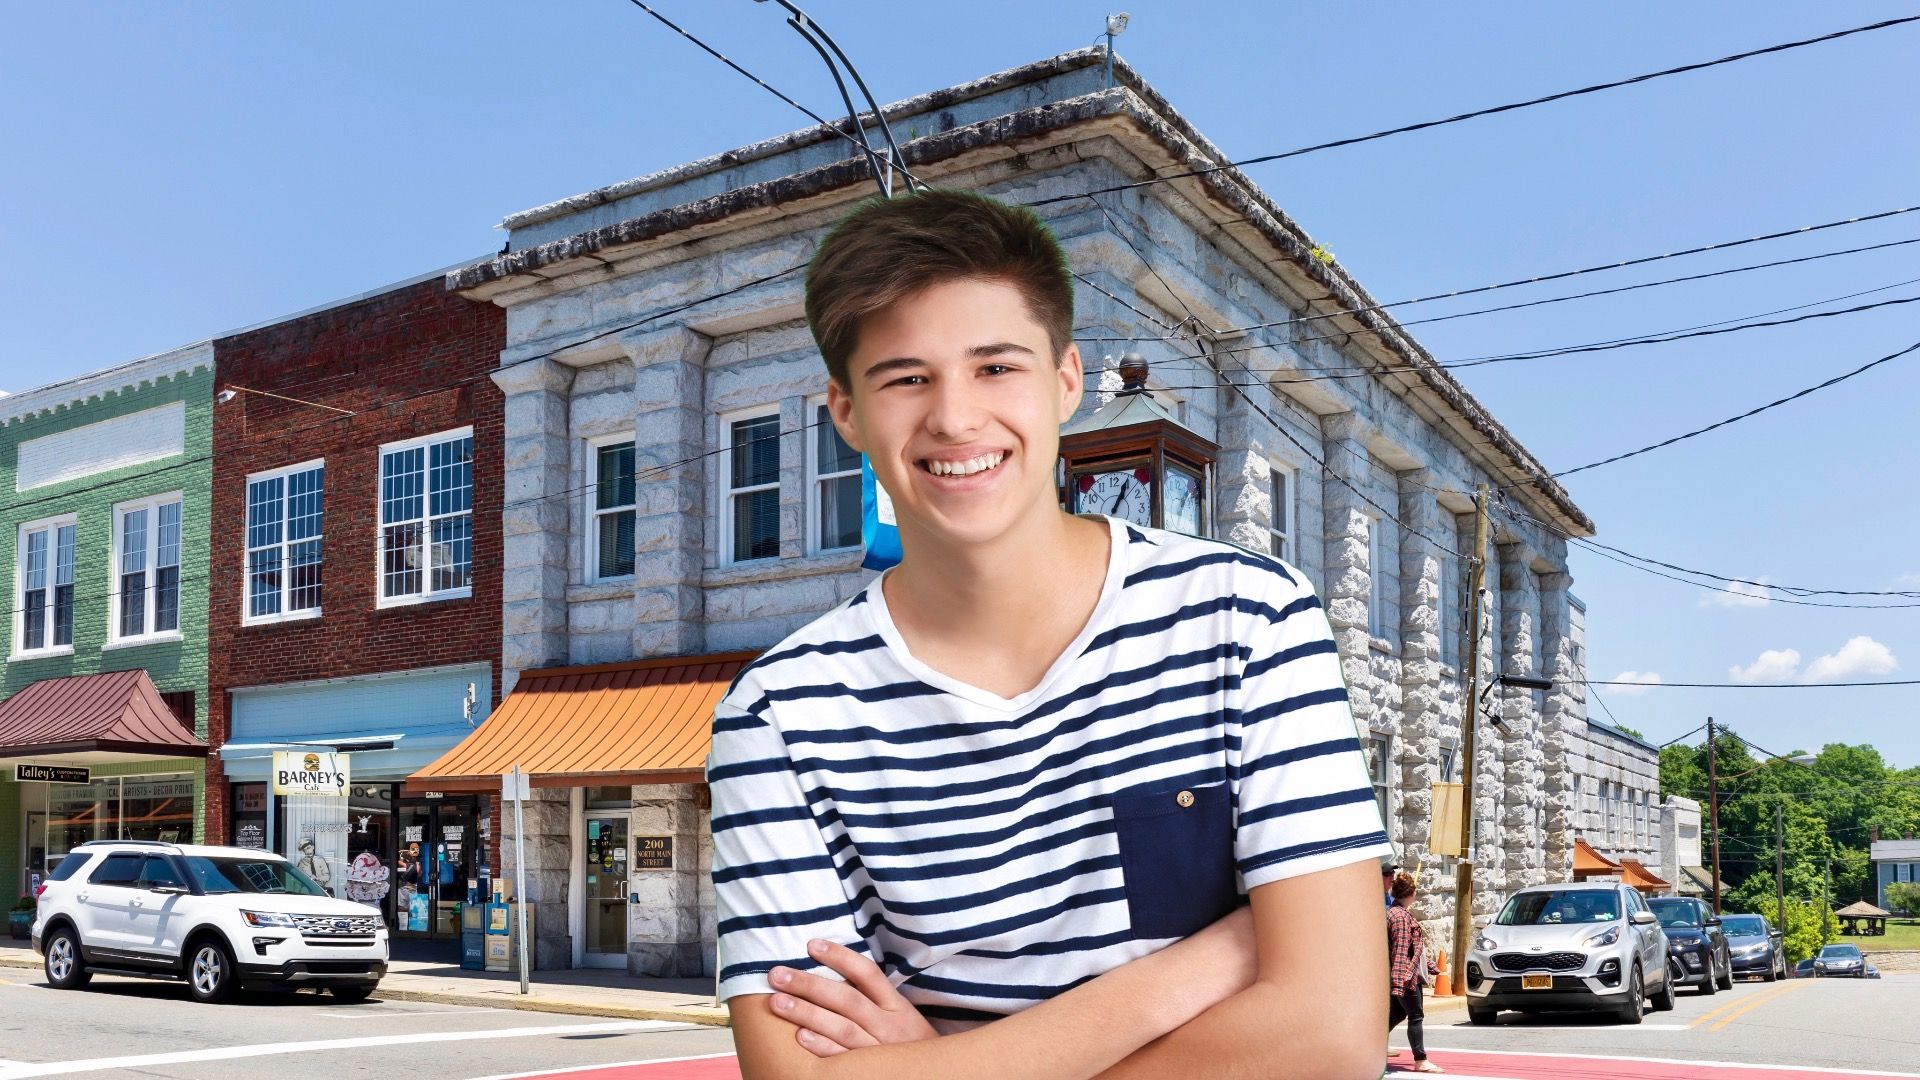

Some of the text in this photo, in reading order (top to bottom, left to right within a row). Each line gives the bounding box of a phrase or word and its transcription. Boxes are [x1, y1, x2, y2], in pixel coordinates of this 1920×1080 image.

[1109, 476, 1119, 487] 12
[1098, 482, 1105, 493] 11
[1088, 493, 1098, 504] 10
[1134, 488, 1141, 499] 2
[1138, 502, 1145, 513] 3
[20, 765, 55, 781] Talley's
[278, 770, 345, 788] BARNEY'S
[123, 785, 147, 797] ARTISTS
[153, 784, 173, 796] DECOR
[644, 839, 664, 849] 200
[637, 850, 672, 858] NORTH MAIN
[642, 858, 664, 866] STREET
